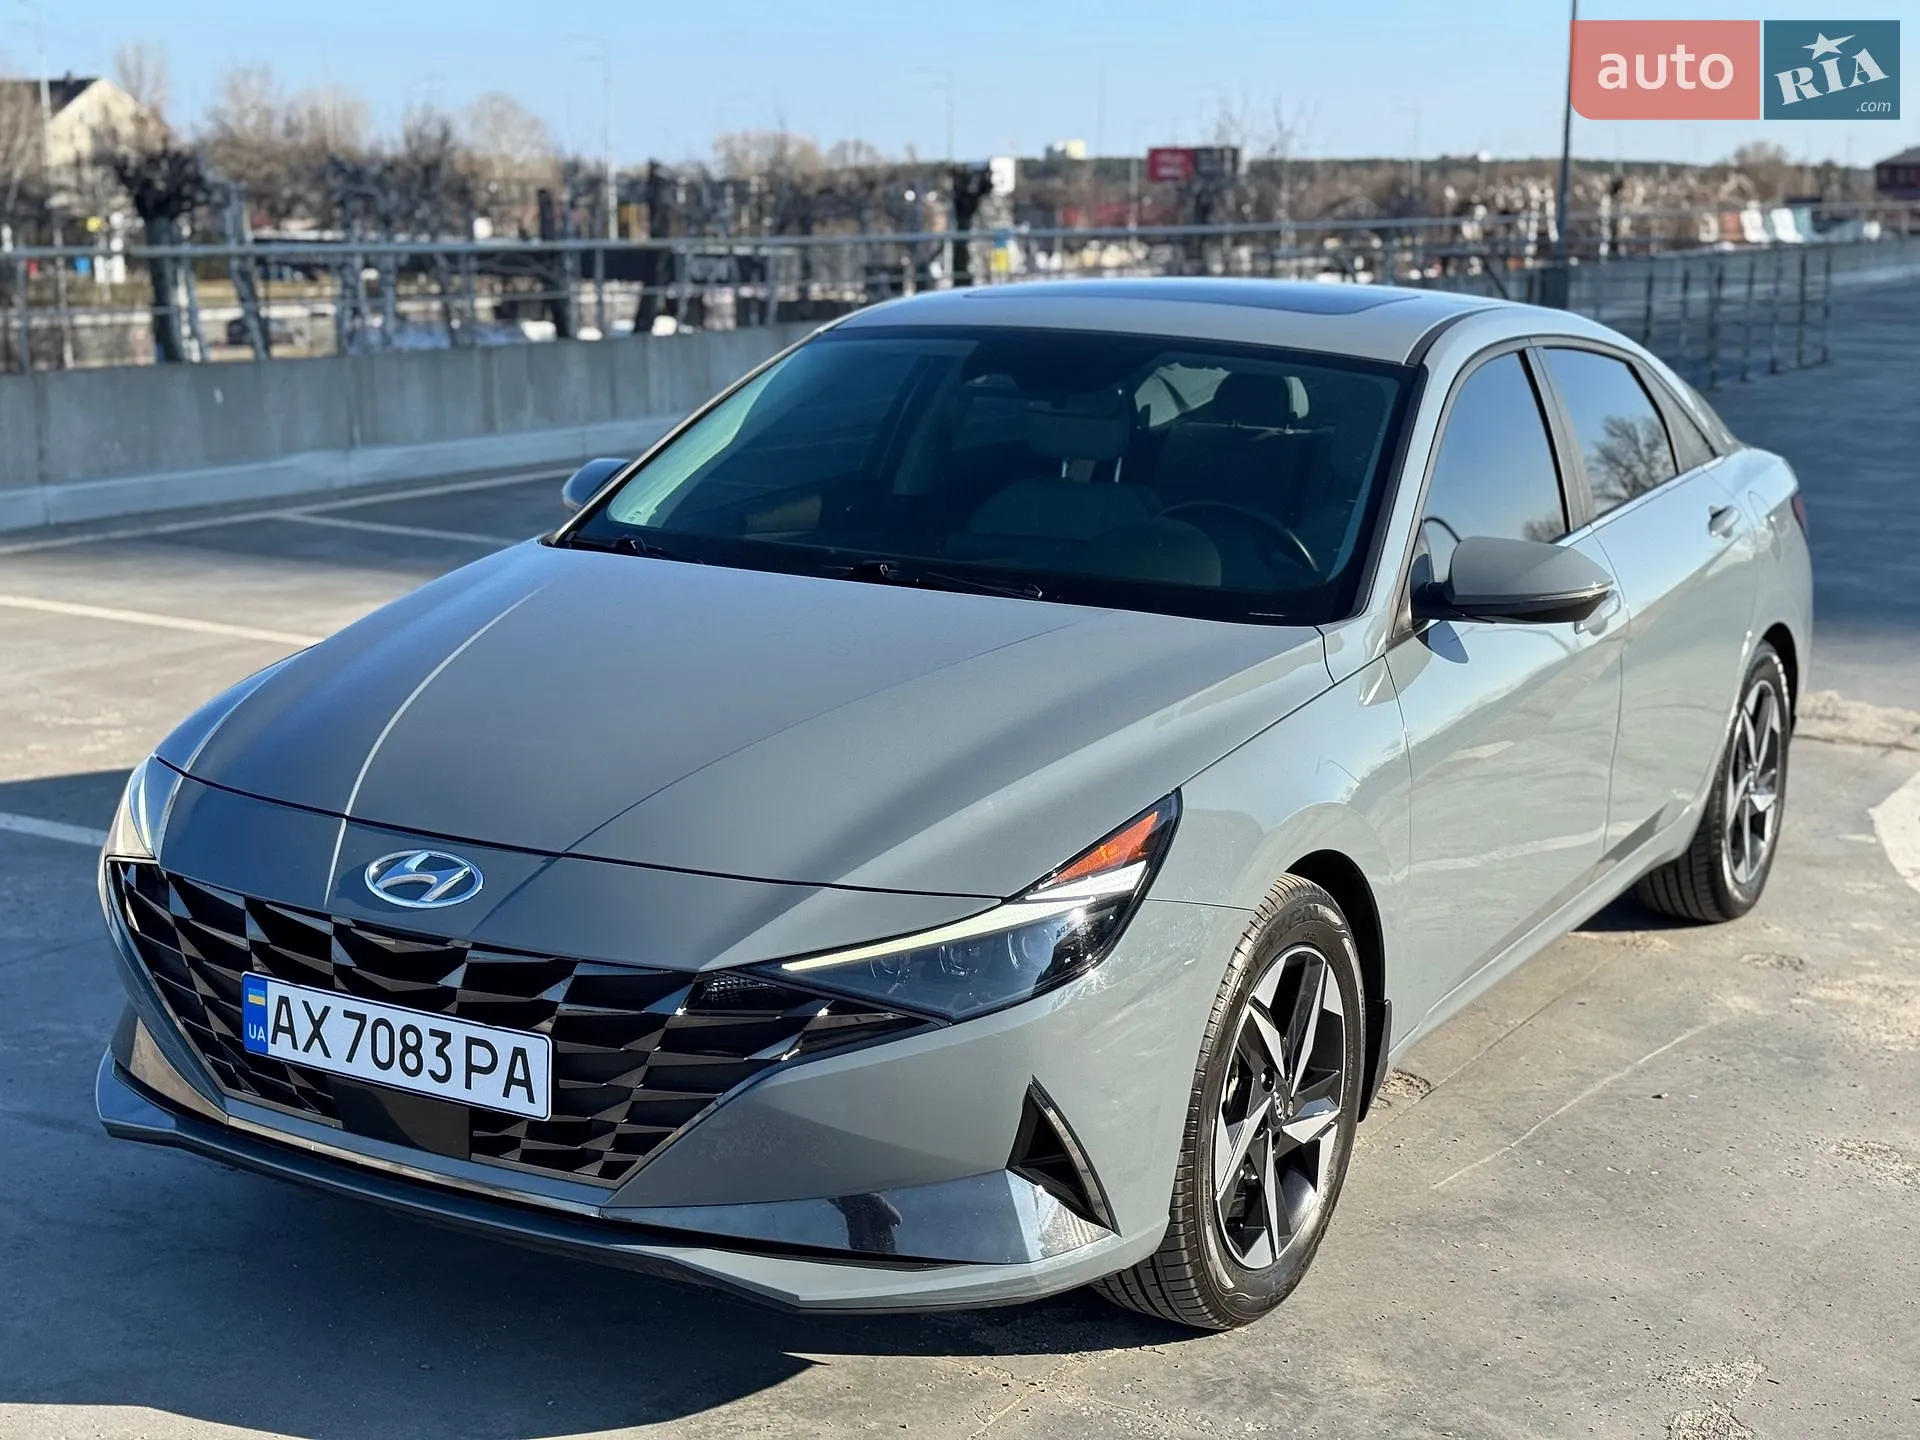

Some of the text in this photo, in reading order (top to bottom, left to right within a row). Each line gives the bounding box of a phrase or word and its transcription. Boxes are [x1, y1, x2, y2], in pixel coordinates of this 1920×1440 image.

[248, 1022, 266, 1043] UA
[270, 995, 536, 1105] AX 7083 PA
